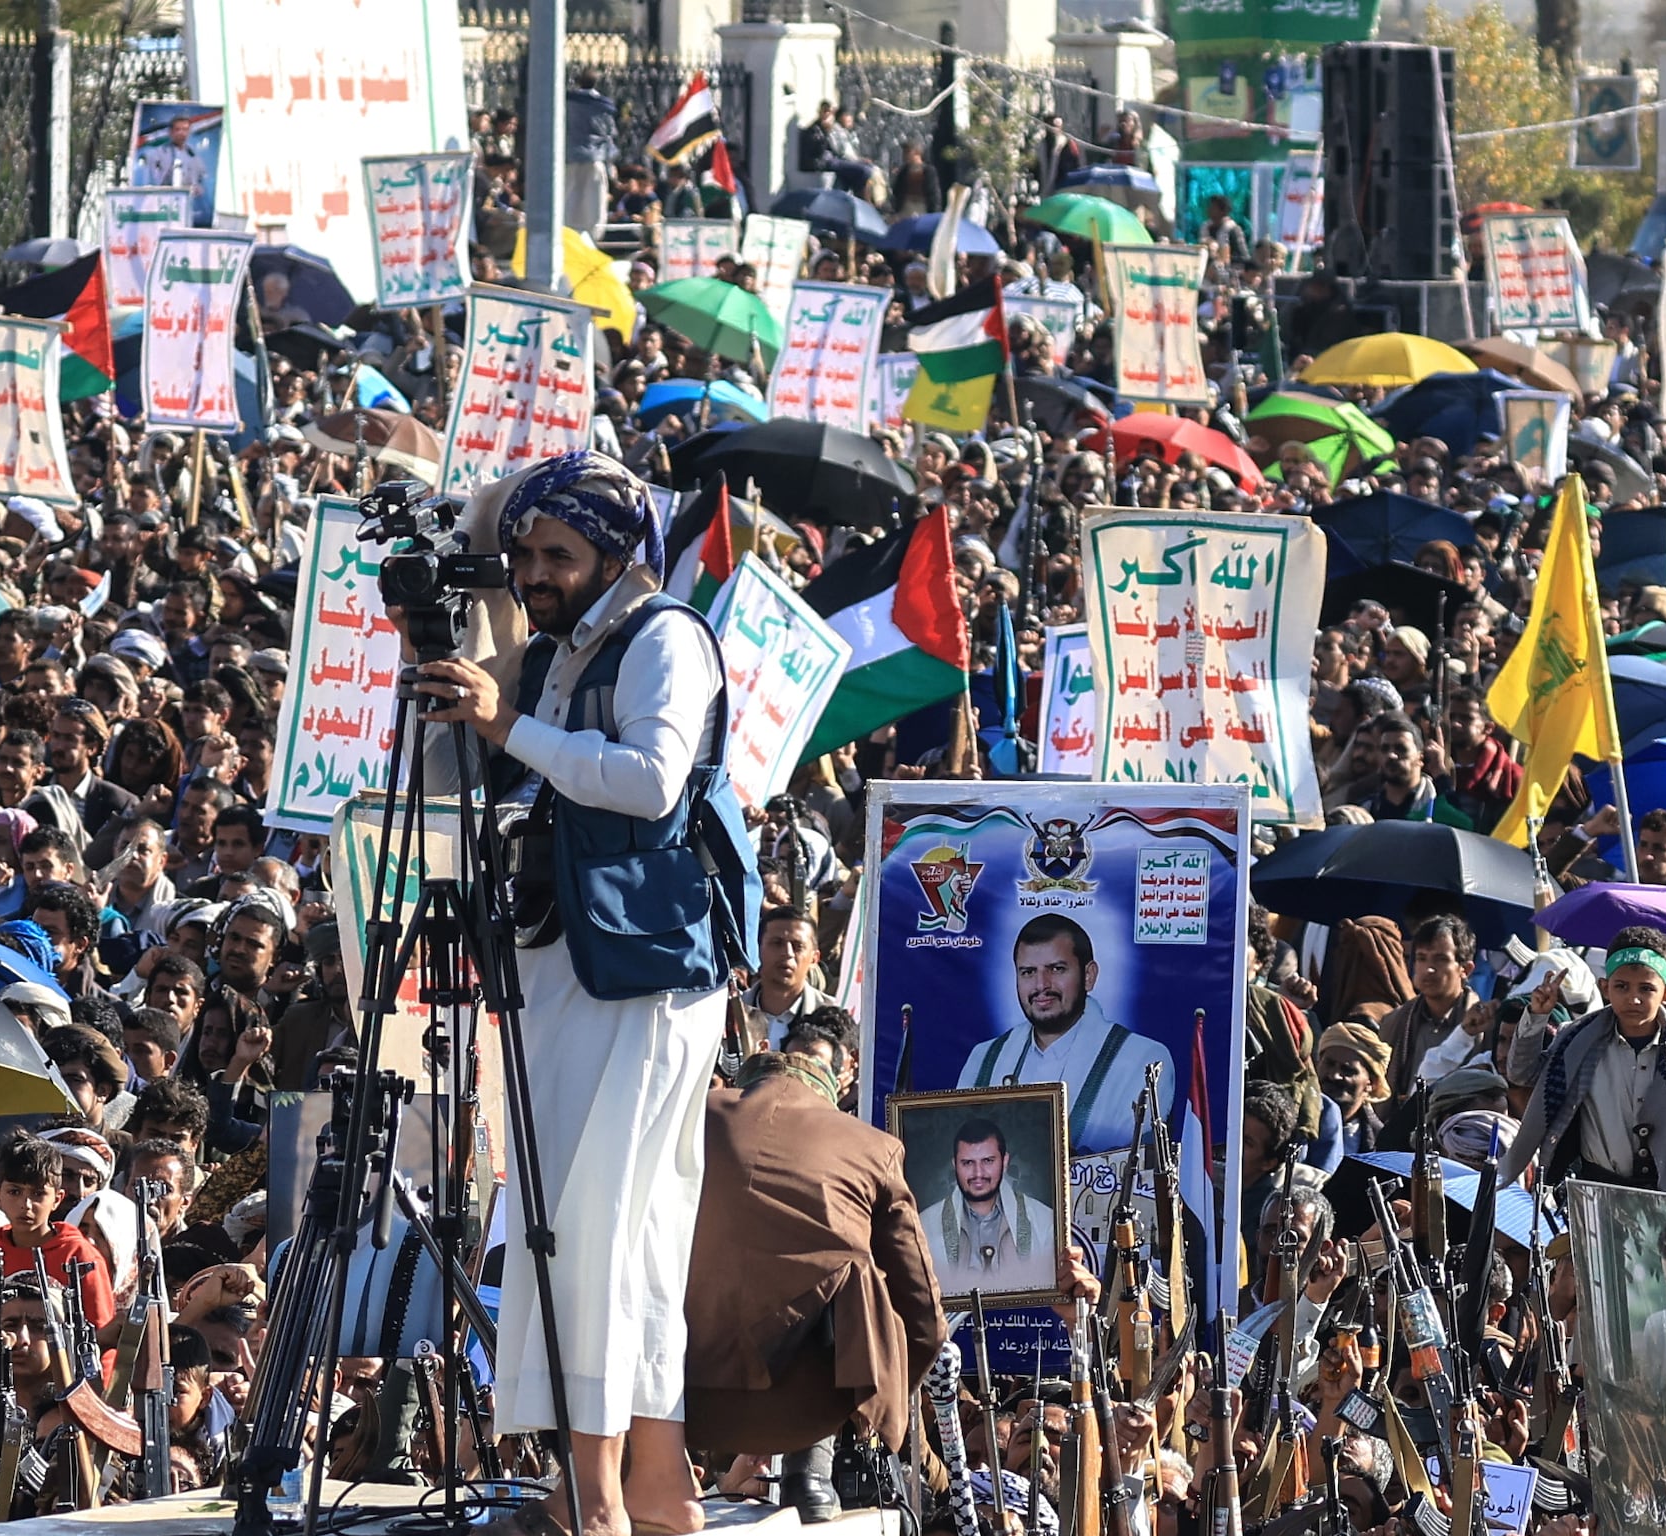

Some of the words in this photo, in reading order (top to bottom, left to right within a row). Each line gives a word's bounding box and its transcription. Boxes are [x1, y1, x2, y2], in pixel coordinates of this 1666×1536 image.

[479, 312, 548, 351] أكبر
[1112, 532, 1206, 599] أكبر
[1211, 546, 1274, 590] الله
[1112, 597, 1199, 645] لأمريكا
[1201, 608, 1268, 647] الموت
[1118, 657, 1197, 698] لإسرائيل
[1204, 659, 1267, 697] الموت
[302, 707, 373, 741] اليهود
[1113, 710, 1171, 750] اليهود
[1180, 709, 1215, 749] على
[1224, 708, 1274, 744] اللعنة
[1142, 851, 1180, 870] أكبر
[1182, 852, 1206, 869] الله
[1140, 873, 1175, 888] لأمريكا
[1176, 874, 1205, 888] الموت
[1140, 889, 1175, 903] لإسرائيل
[1176, 890, 1205, 903] الموت
[1139, 906, 1165, 920] اليهود
[1165, 906, 1176, 918] على
[1177, 906, 1204, 918] اللعنة
[1138, 922, 1174, 939] للإسلام
[1176, 922, 1203, 937] النصر
[907, 937, 933, 947] التحرير
[954, 937, 981, 947] طوفان
